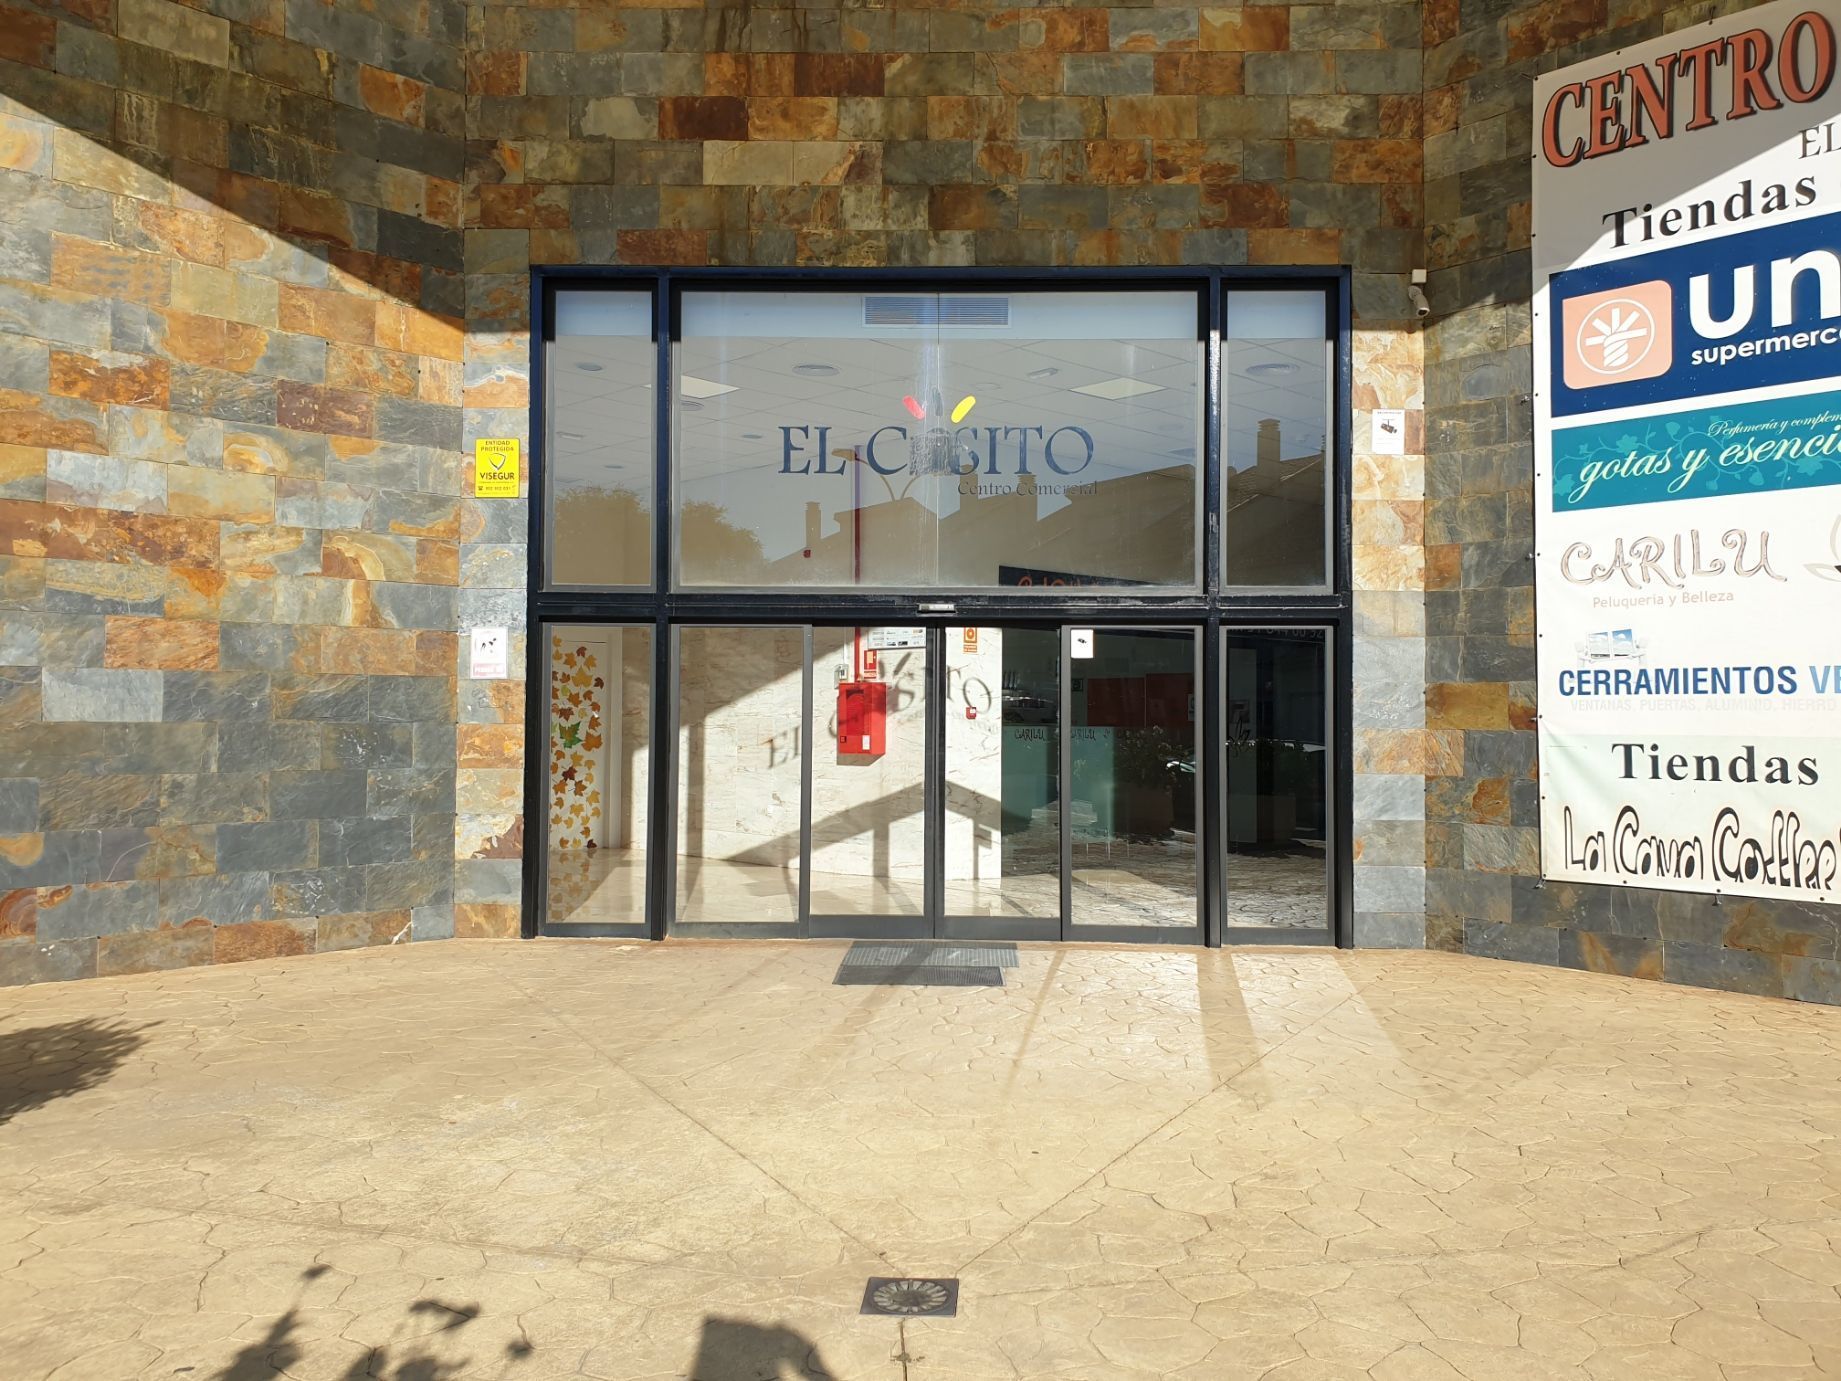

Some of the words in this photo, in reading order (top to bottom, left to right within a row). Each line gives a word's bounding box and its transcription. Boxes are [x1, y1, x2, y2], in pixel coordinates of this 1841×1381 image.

[1542, 11, 1836, 168] CENTRO
[1798, 123, 1841, 159] EL
[1602, 175, 1816, 249] Tiendas
[1691, 328, 1841, 365] supermerc
[1708, 419, 1777, 438] Perfumería
[1776, 420, 1788, 435] y
[778, 425, 847, 475] EL
[1568, 446, 1671, 503] gotas
[1667, 447, 1710, 493] y
[1719, 425, 1841, 466] esenci
[480, 472, 515, 480] VISEGUR
[958, 482, 1012, 495] Centro
[1560, 528, 1787, 589] CARILU
[1668, 595, 1677, 606] y
[1681, 591, 1734, 604] Belleza
[1559, 665, 1797, 696] CERRAMIENTOS
[1612, 743, 1818, 785] Tiendas
[1564, 806, 1607, 872] La
[1613, 805, 1704, 880] Cava
[1712, 807, 1836, 890] Coffee
